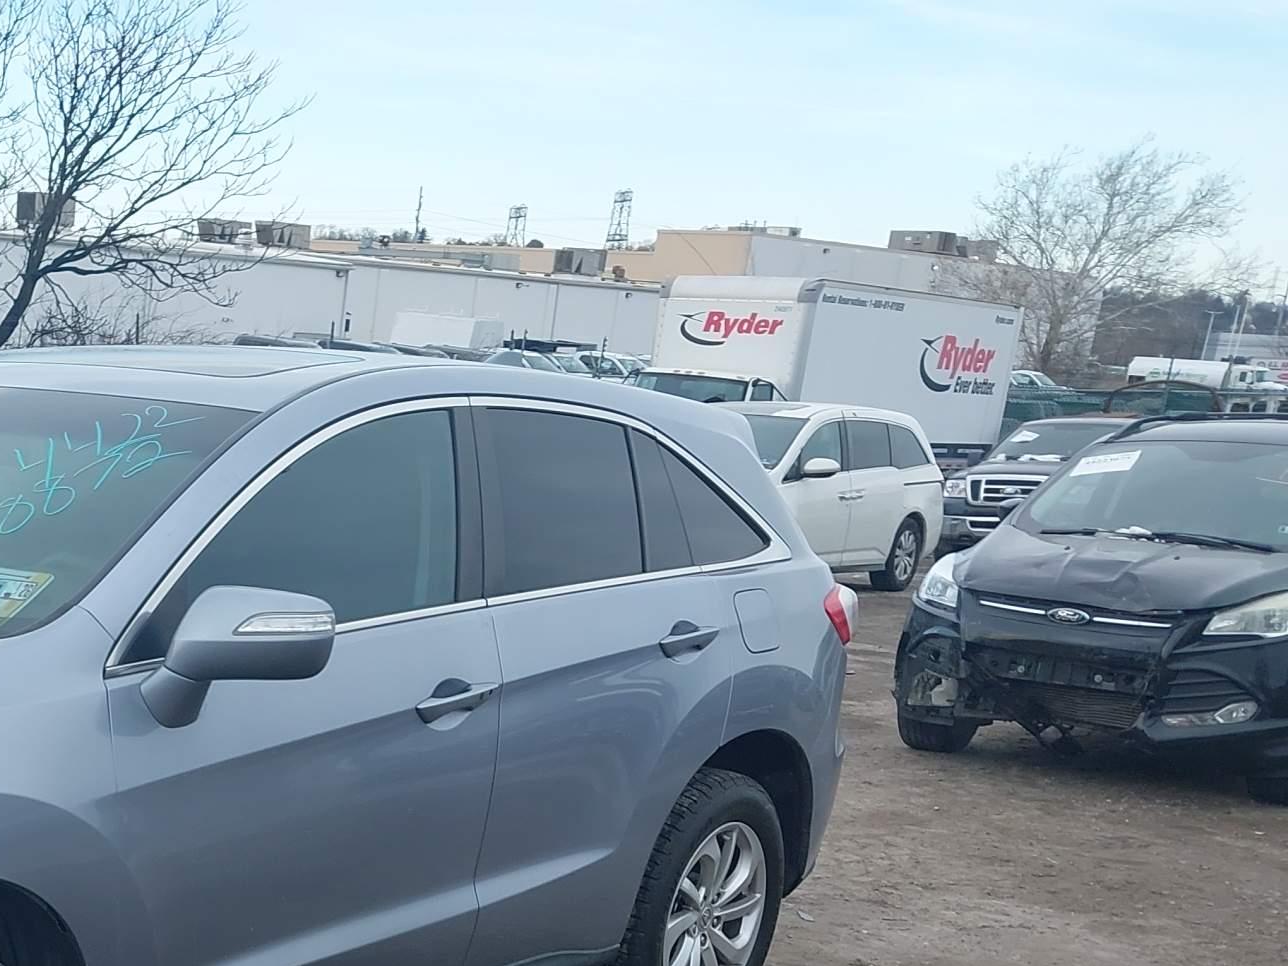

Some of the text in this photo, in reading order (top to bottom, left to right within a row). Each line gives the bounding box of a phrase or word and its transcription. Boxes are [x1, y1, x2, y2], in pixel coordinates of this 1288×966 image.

[703, 311, 784, 338] Ryder
[936, 335, 996, 379] Ryder
[954, 375, 973, 393] Ever
